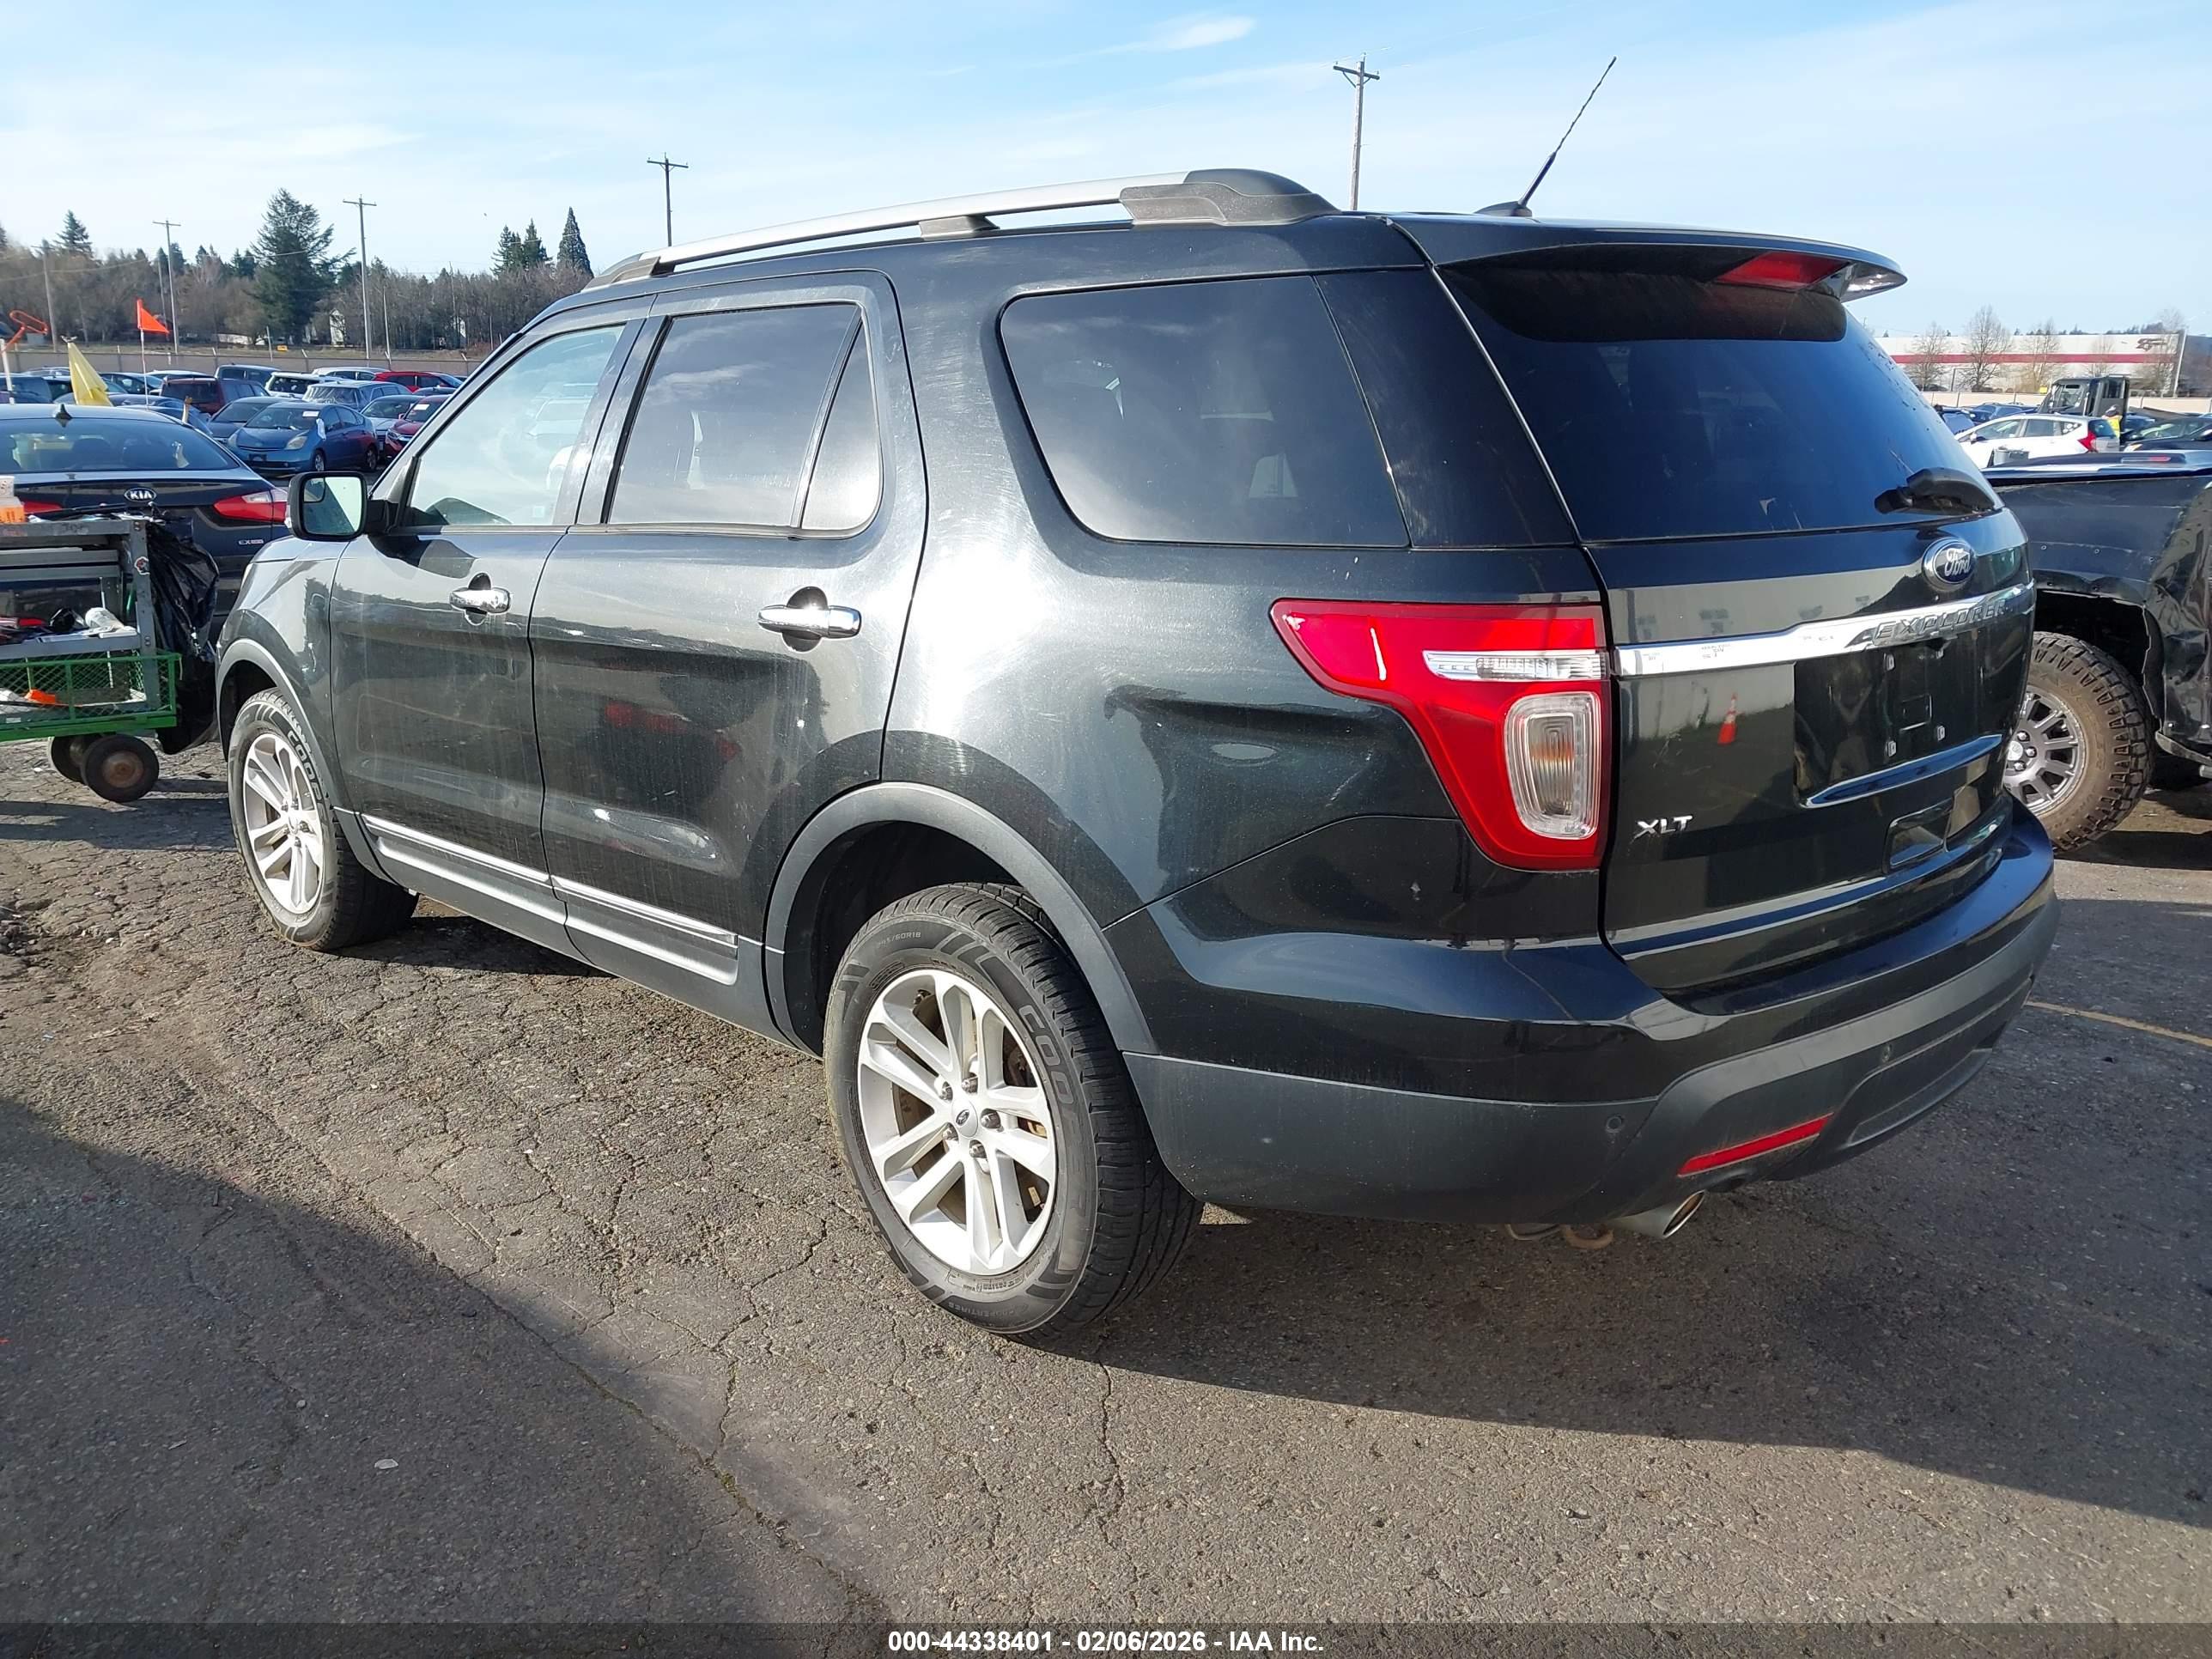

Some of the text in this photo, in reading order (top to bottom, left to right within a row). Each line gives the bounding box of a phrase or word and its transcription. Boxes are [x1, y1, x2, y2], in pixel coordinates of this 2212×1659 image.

[130, 490, 152, 500] KIA
[1944, 547, 1971, 576] Ford
[1875, 599, 2007, 640] EXPLORER
[1633, 815, 1693, 840] XLT
